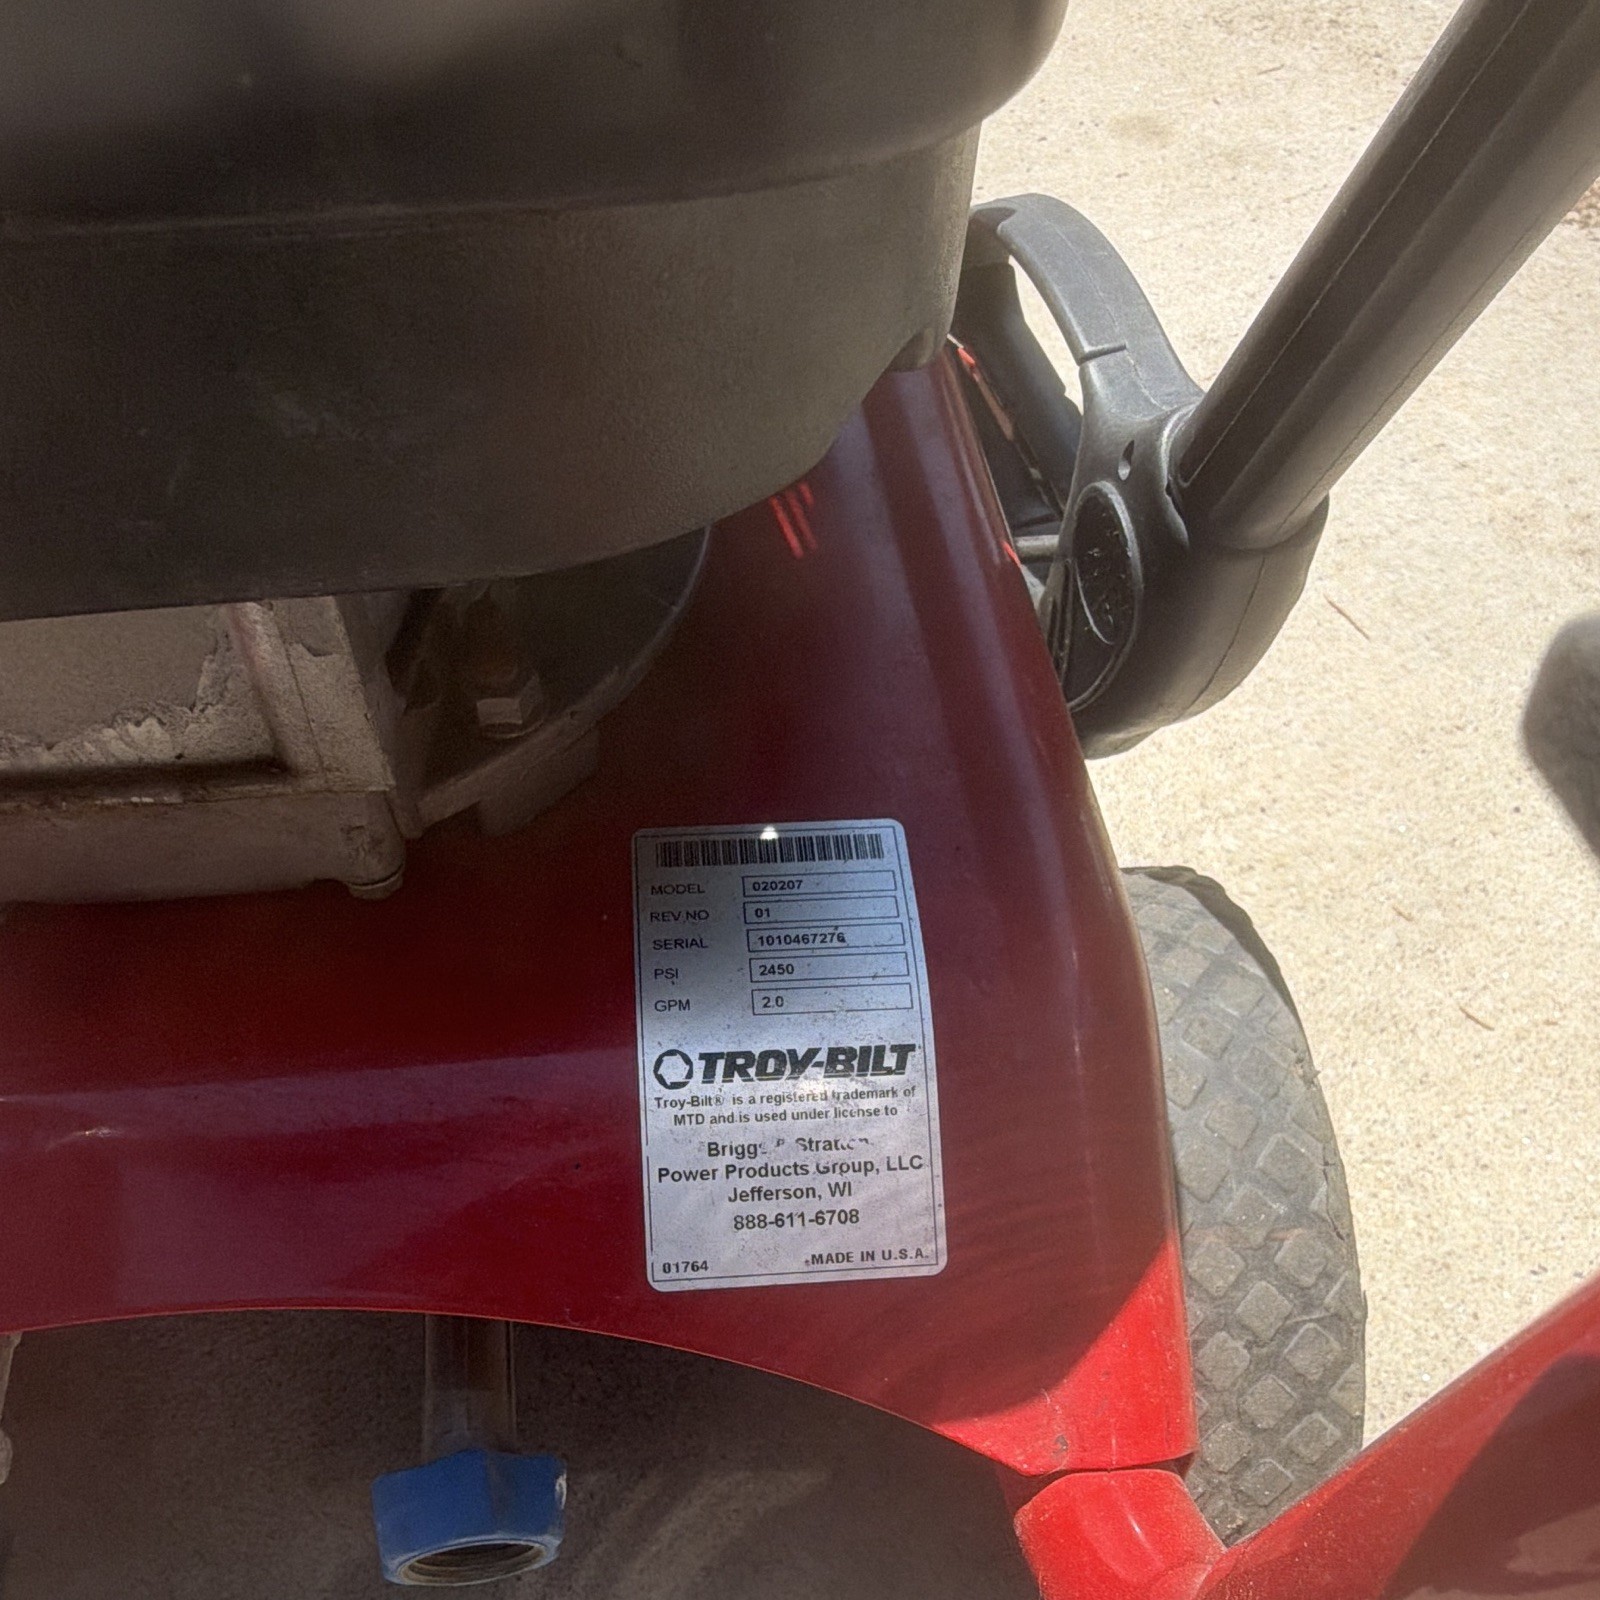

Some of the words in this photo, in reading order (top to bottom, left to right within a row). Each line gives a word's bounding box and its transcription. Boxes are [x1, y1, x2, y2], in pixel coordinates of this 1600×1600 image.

[650, 883, 706, 896] MODEL
[752, 880, 803, 892] 020207
[754, 908, 771, 918] 01
[652, 937, 709, 951] SERIAL
[653, 968, 679, 980] PSI
[759, 964, 795, 976] 2450
[654, 999, 691, 1012] GPM
[762, 996, 785, 1008] 2.0
[698, 1043, 916, 1084] TROY-BILT
[732, 1094, 744, 1105] is
[749, 1095, 756, 1104] a
[760, 1089, 828, 1106] registered
[832, 1086, 898, 1101] trademark
[903, 1085, 917, 1098] of
[673, 1113, 705, 1126] MTD
[709, 1112, 735, 1124] and
[739, 1111, 750, 1123] is
[755, 1109, 787, 1122] used
[791, 1108, 830, 1121] under
[834, 1106, 881, 1119] license
[884, 1105, 898, 1116] to
[658, 1167, 718, 1183] Power
[725, 1163, 810, 1180] Products
[816, 1158, 881, 1177] Group,
[886, 1155, 924, 1171] LLC
[728, 1184, 822, 1203] Jefferson,
[828, 1182, 853, 1197] WI
[733, 1209, 860, 1230] 888-611-6708
[811, 1251, 854, 1265] MADE
[860, 1250, 875, 1262] IN
[881, 1247, 929, 1261] U.S.A.
[662, 1261, 709, 1274] 01764
